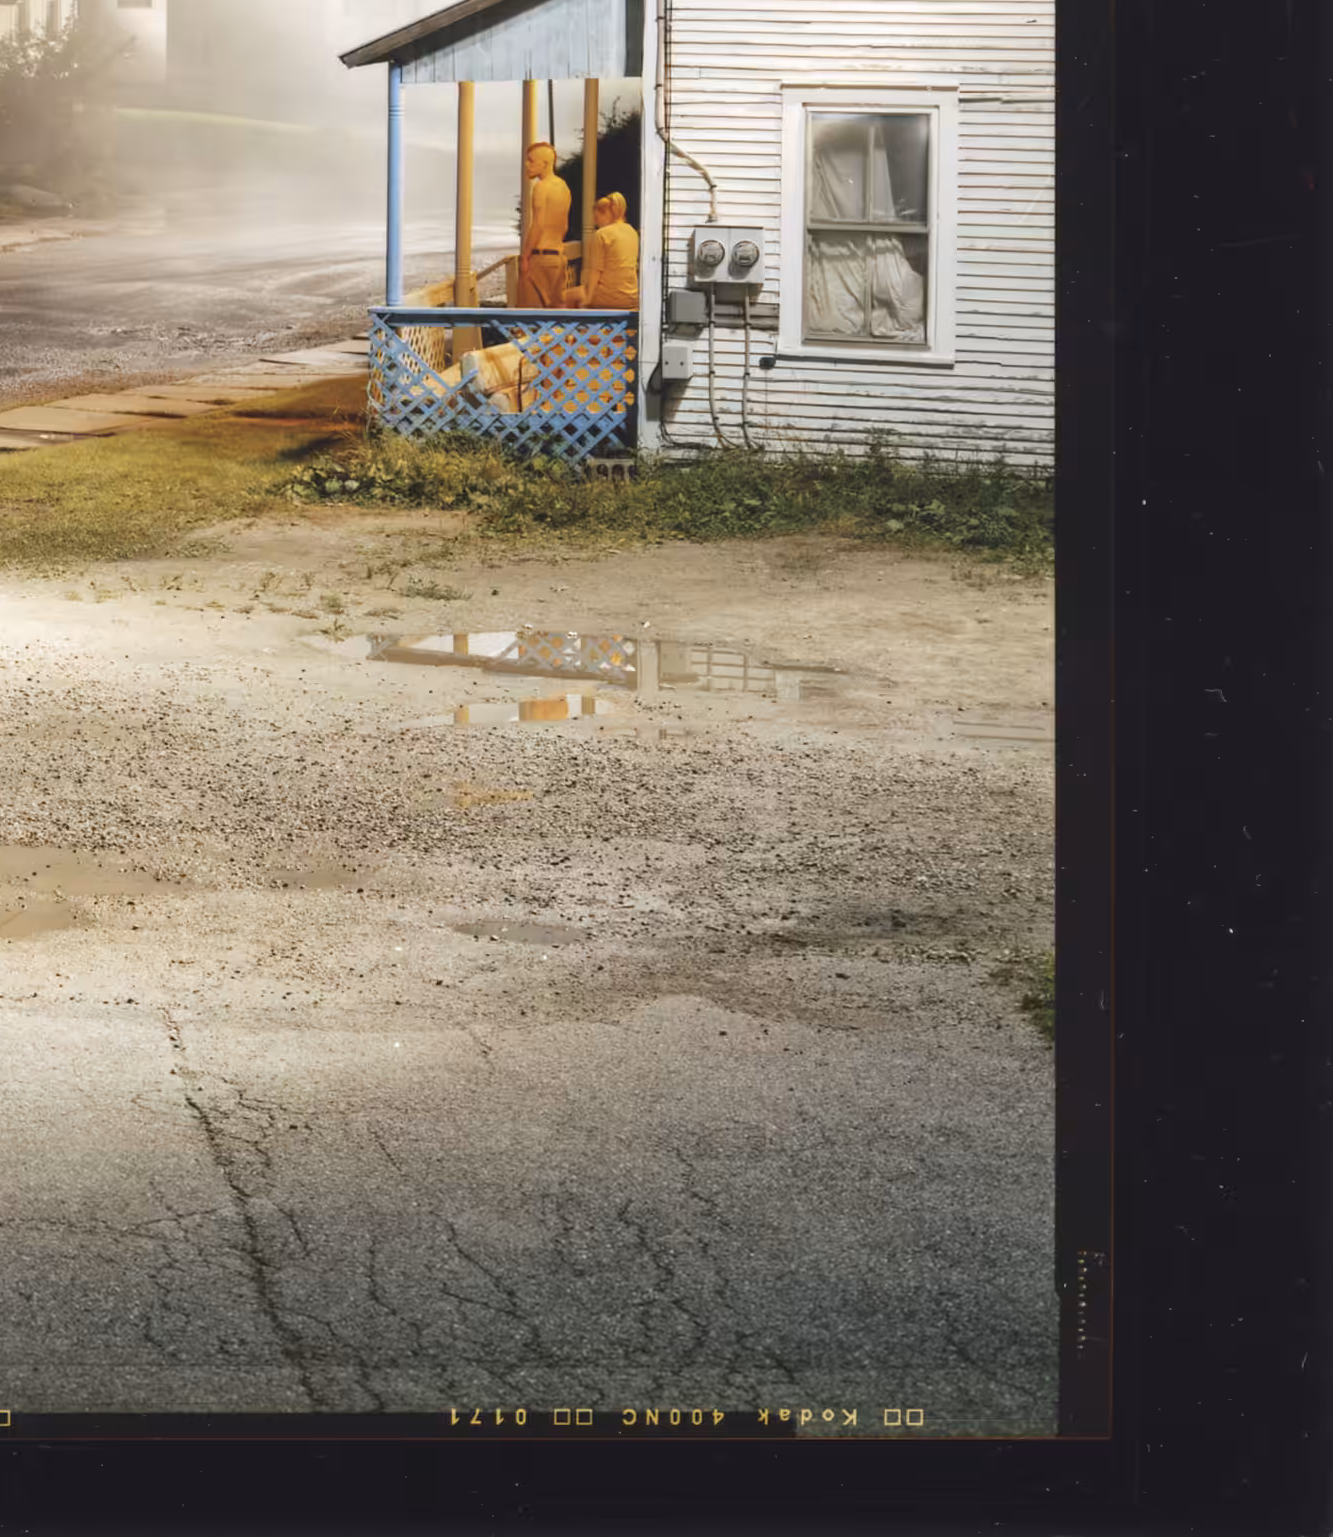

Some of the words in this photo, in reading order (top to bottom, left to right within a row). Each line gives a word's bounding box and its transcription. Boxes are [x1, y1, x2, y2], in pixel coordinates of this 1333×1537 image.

[450, 1408, 528, 1427] 0171
[622, 1408, 724, 1427] 400NC
[758, 1408, 858, 1427] Kodak
